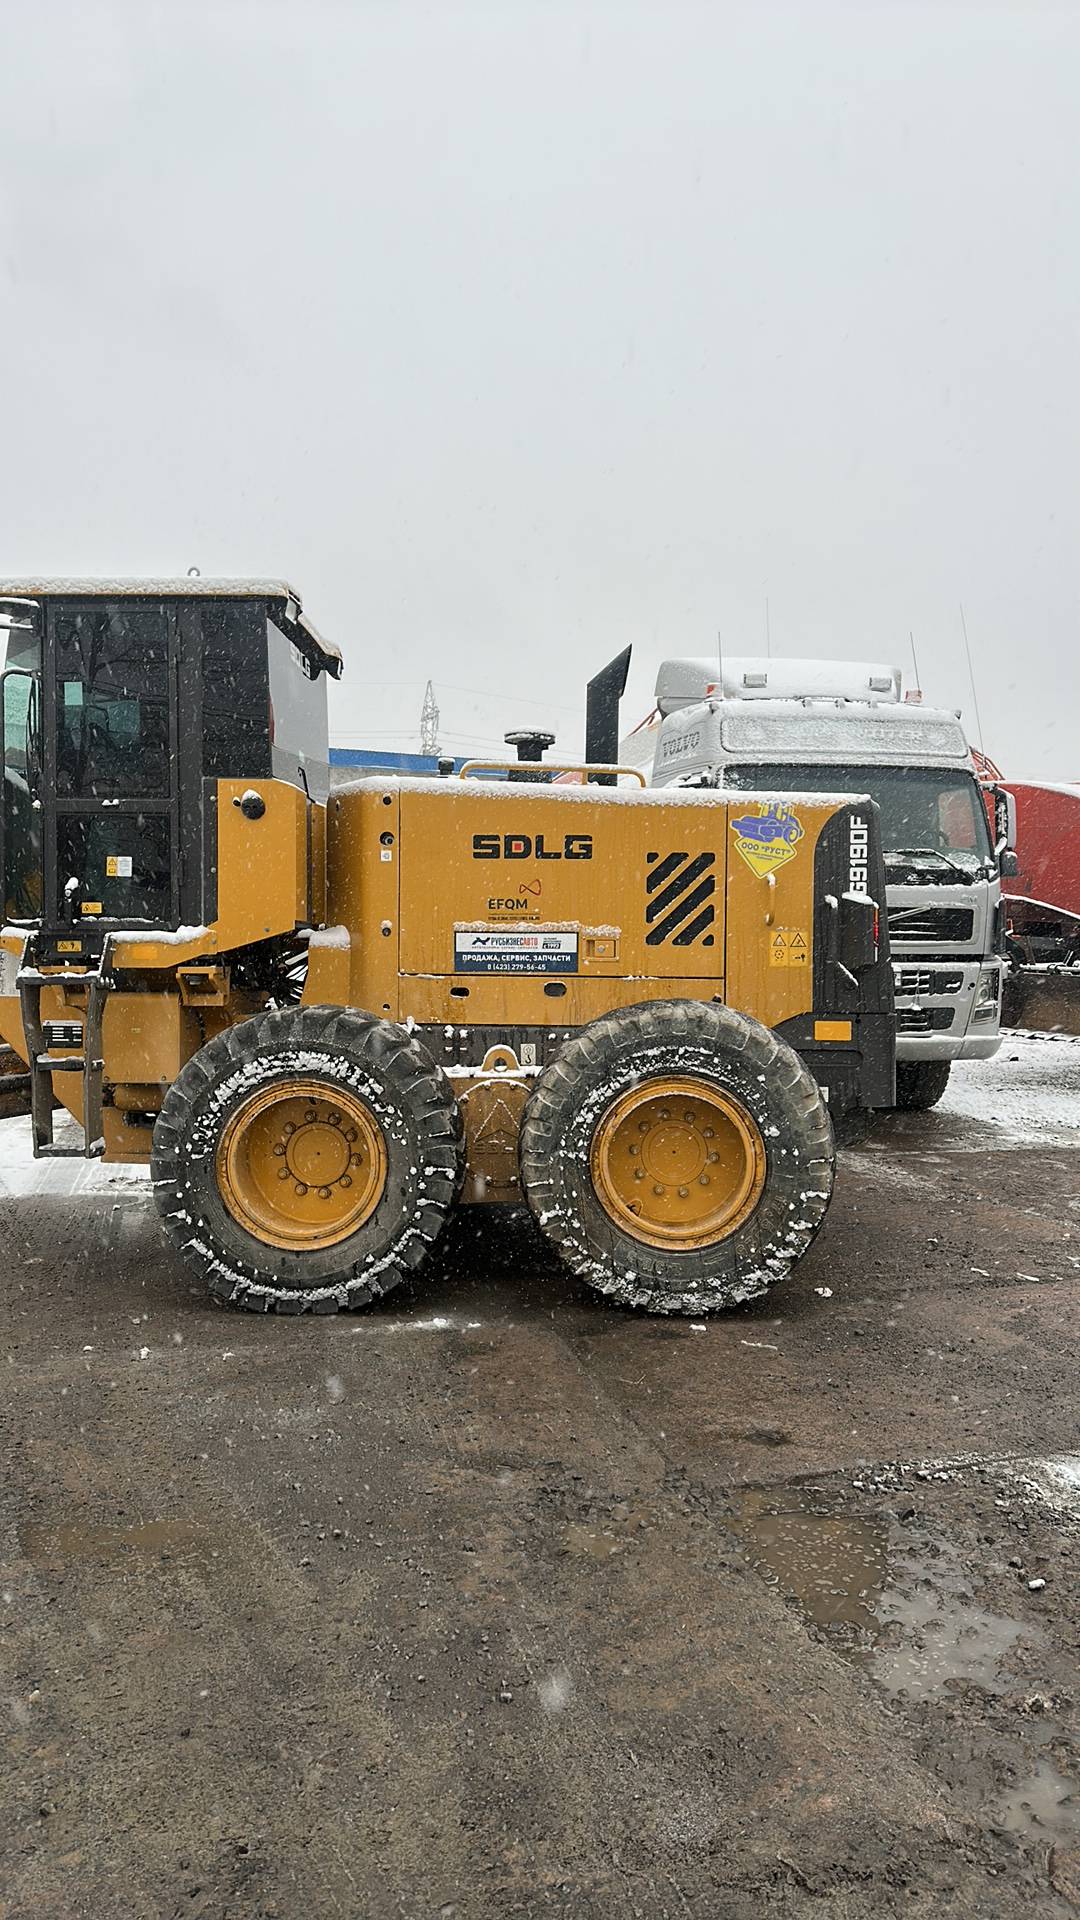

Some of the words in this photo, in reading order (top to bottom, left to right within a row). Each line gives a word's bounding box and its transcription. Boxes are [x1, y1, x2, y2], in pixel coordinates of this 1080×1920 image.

[662, 731, 700, 757] VOLVO
[473, 835, 593, 859] SDLG
[742, 842, 759, 850] ООО
[850, 815, 868, 894] G9190F
[488, 898, 528, 910] EFQM
[462, 954, 500, 962] ПРОДАЖА,
